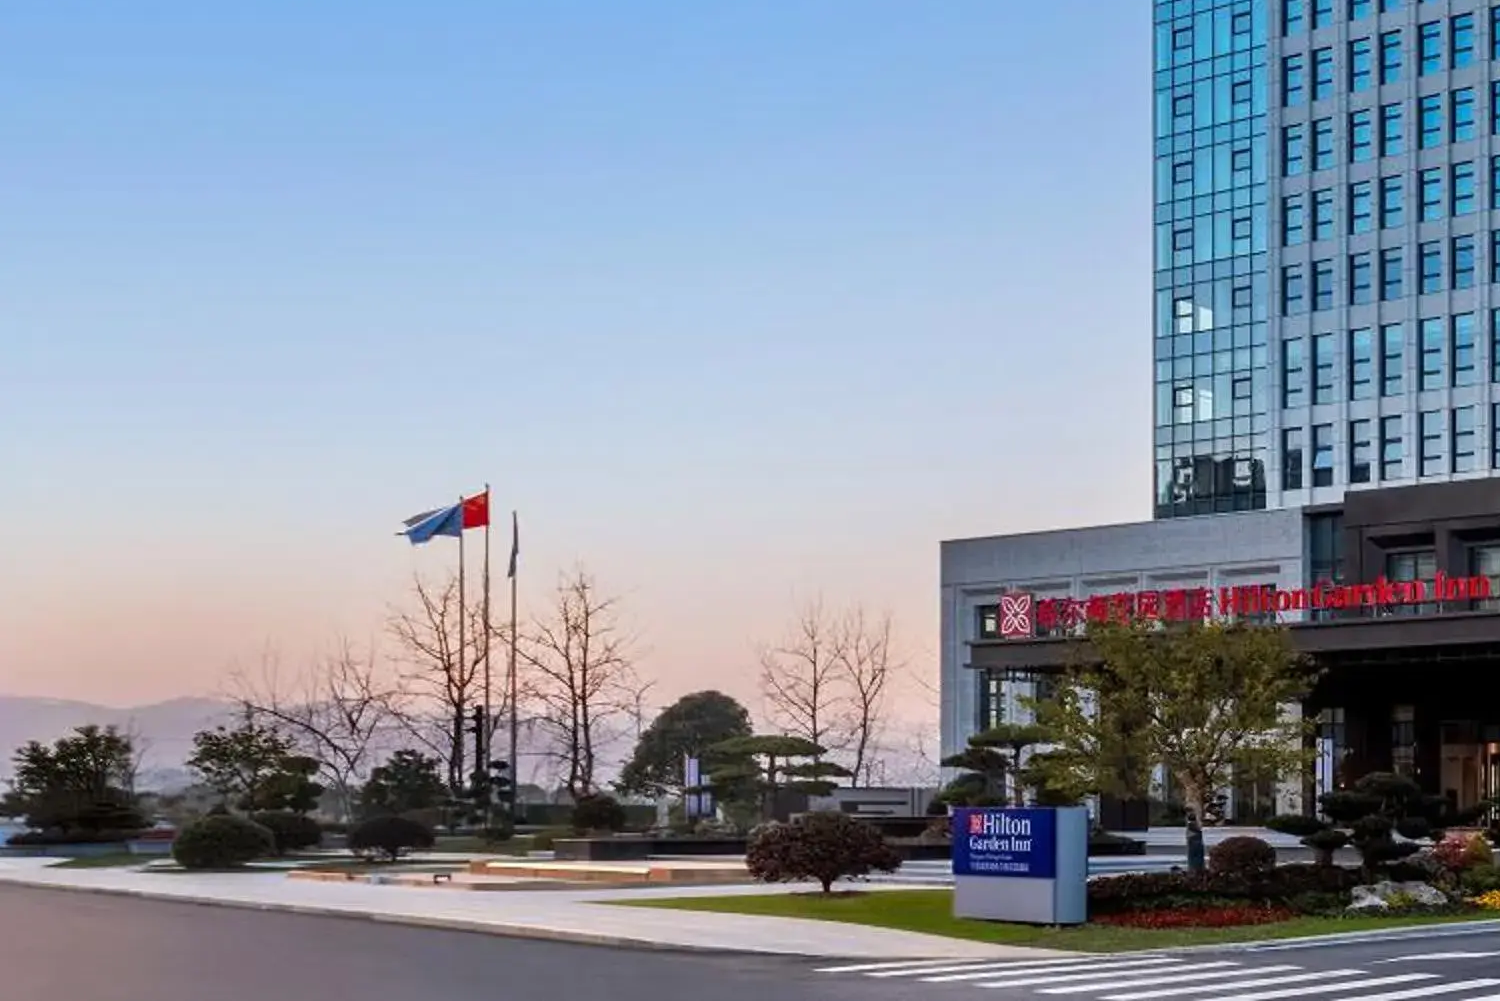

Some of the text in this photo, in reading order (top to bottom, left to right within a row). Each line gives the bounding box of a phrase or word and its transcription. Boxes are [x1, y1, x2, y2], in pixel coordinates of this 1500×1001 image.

[1219, 582, 1309, 615] Hilton
[1311, 574, 1427, 610] Garden
[1434, 569, 1491, 601] Inn
[983, 813, 1031, 835] Hilton
[969, 835, 1031, 851] Garden Inn
